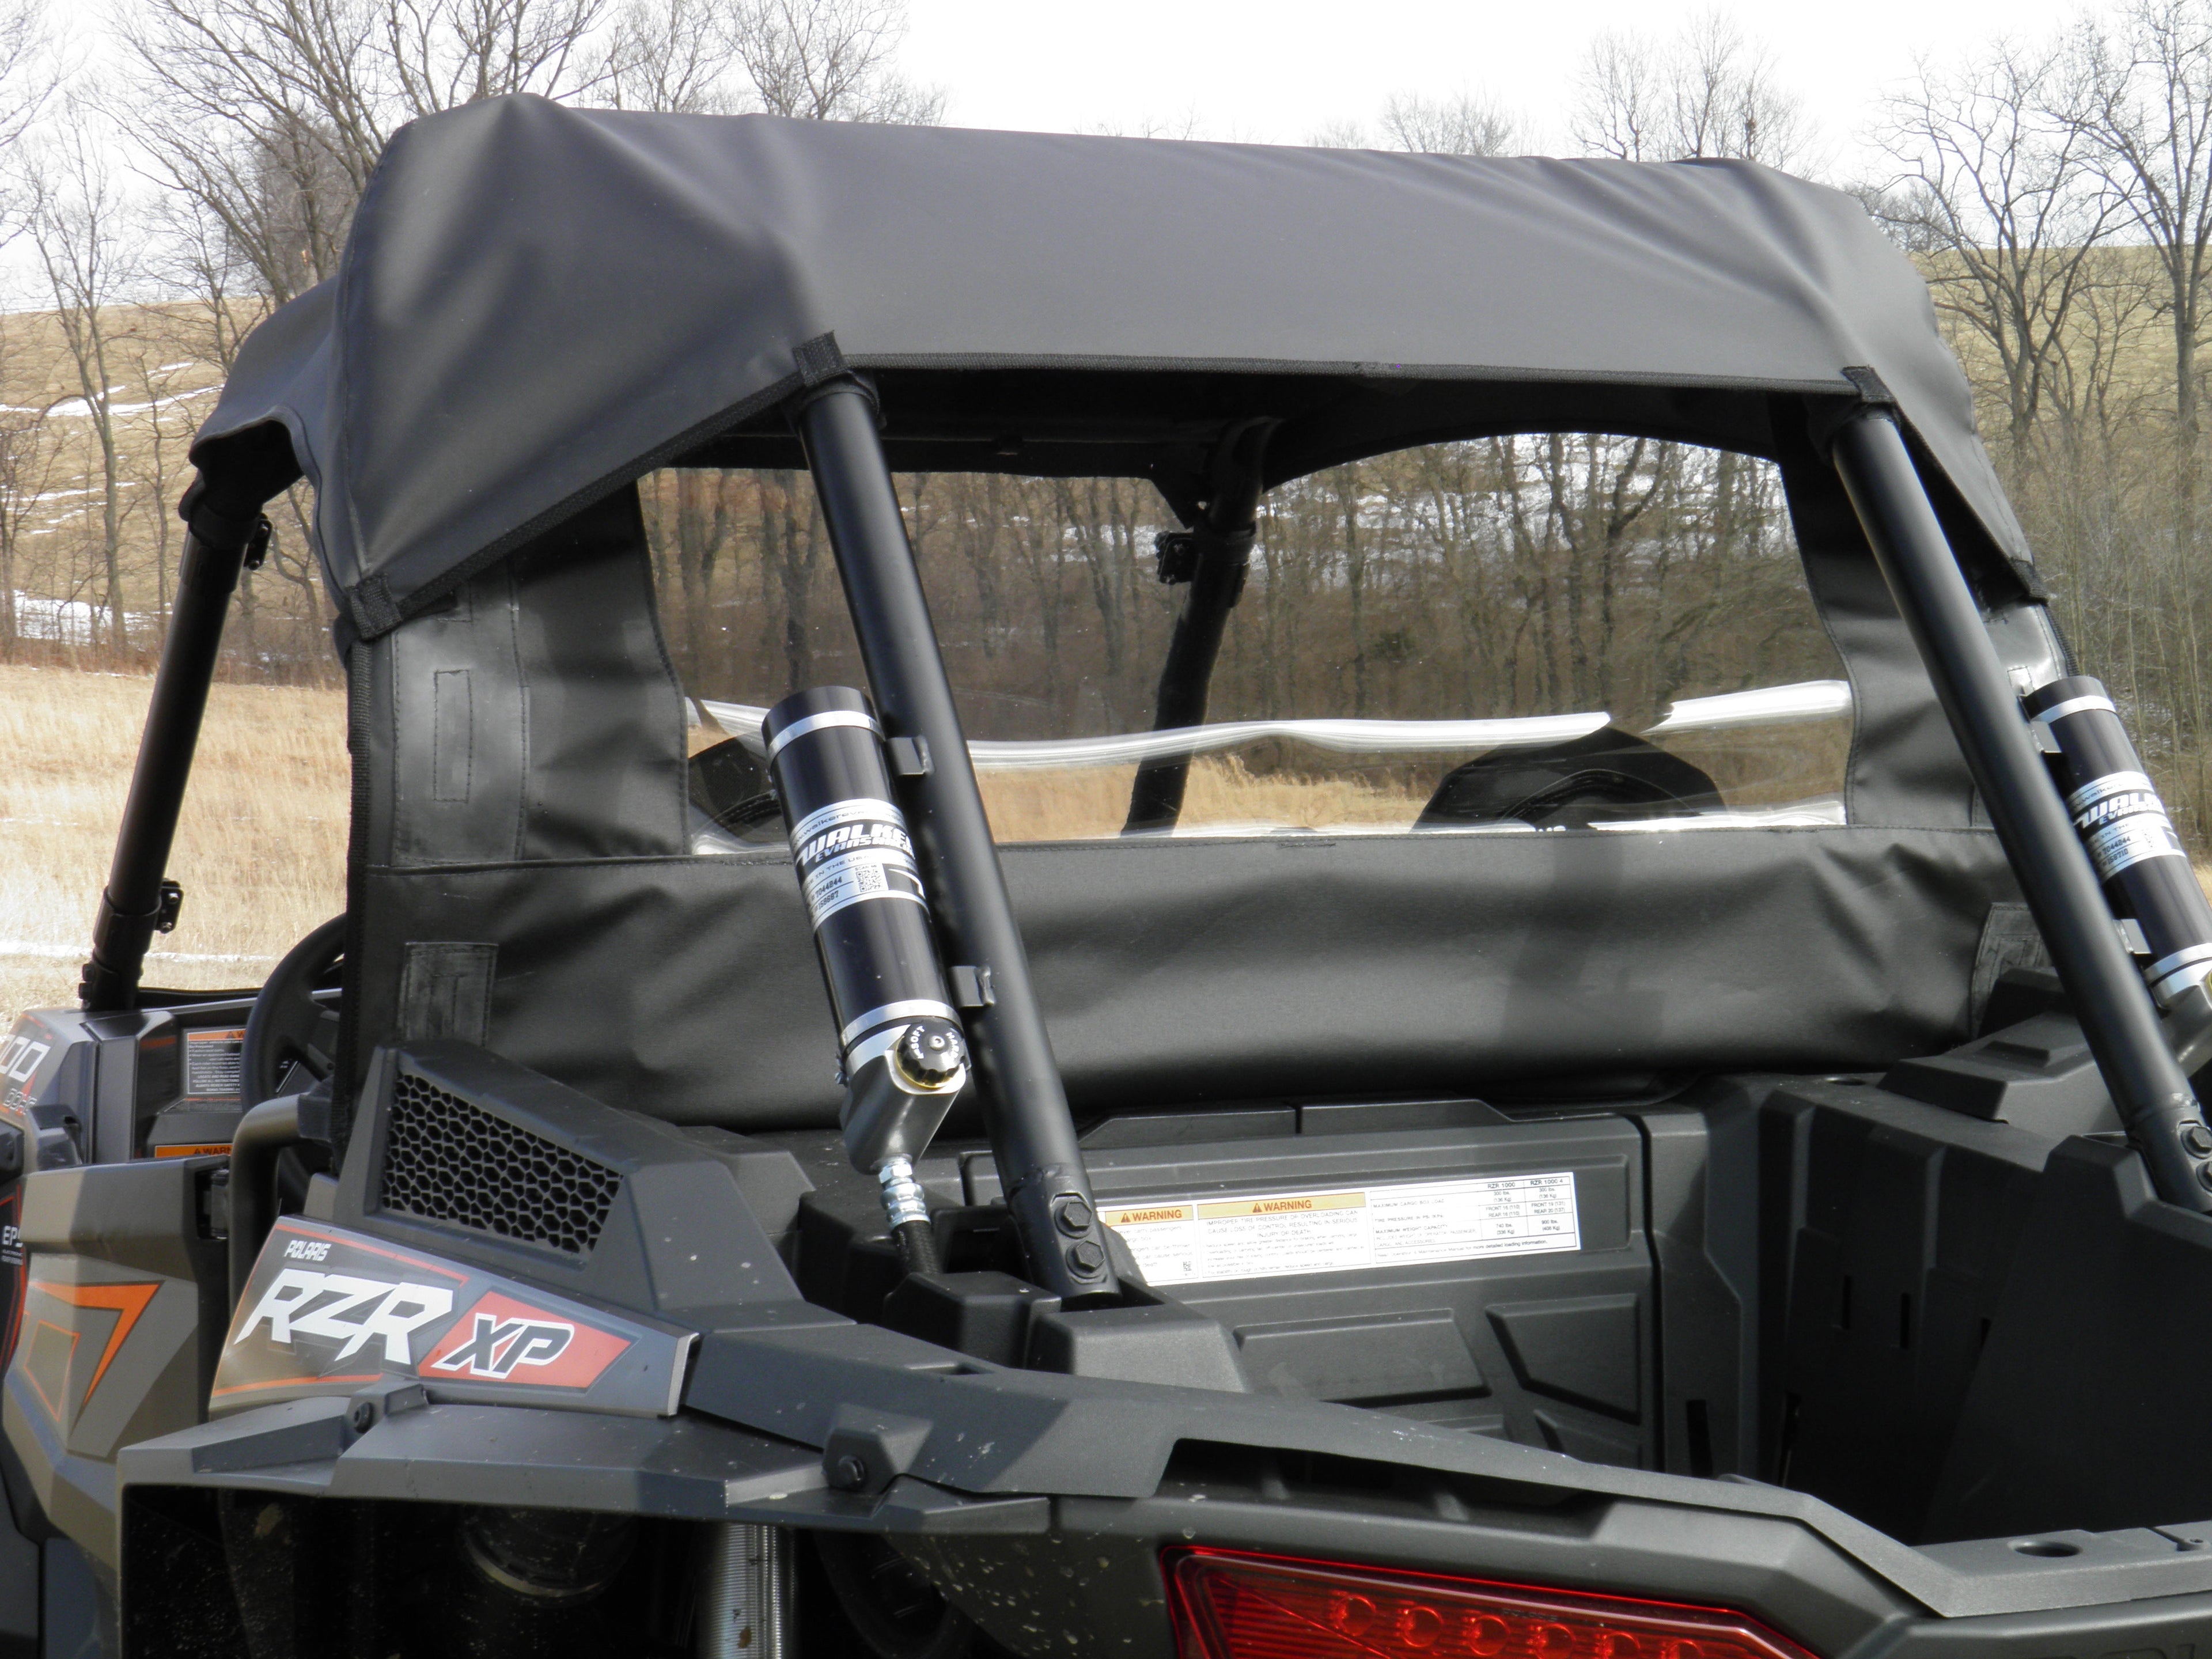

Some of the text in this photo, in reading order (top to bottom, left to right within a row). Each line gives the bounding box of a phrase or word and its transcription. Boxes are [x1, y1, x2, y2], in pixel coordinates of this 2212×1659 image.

[816, 837, 872, 862] EVANS
[911, 1026, 925, 1049] SOFT
[1132, 1210, 1182, 1221] WARNING
[1263, 1200, 1312, 1211] WARNING
[284, 1240, 332, 1261] POLARIS
[233, 1268, 575, 1379] RZR XP
